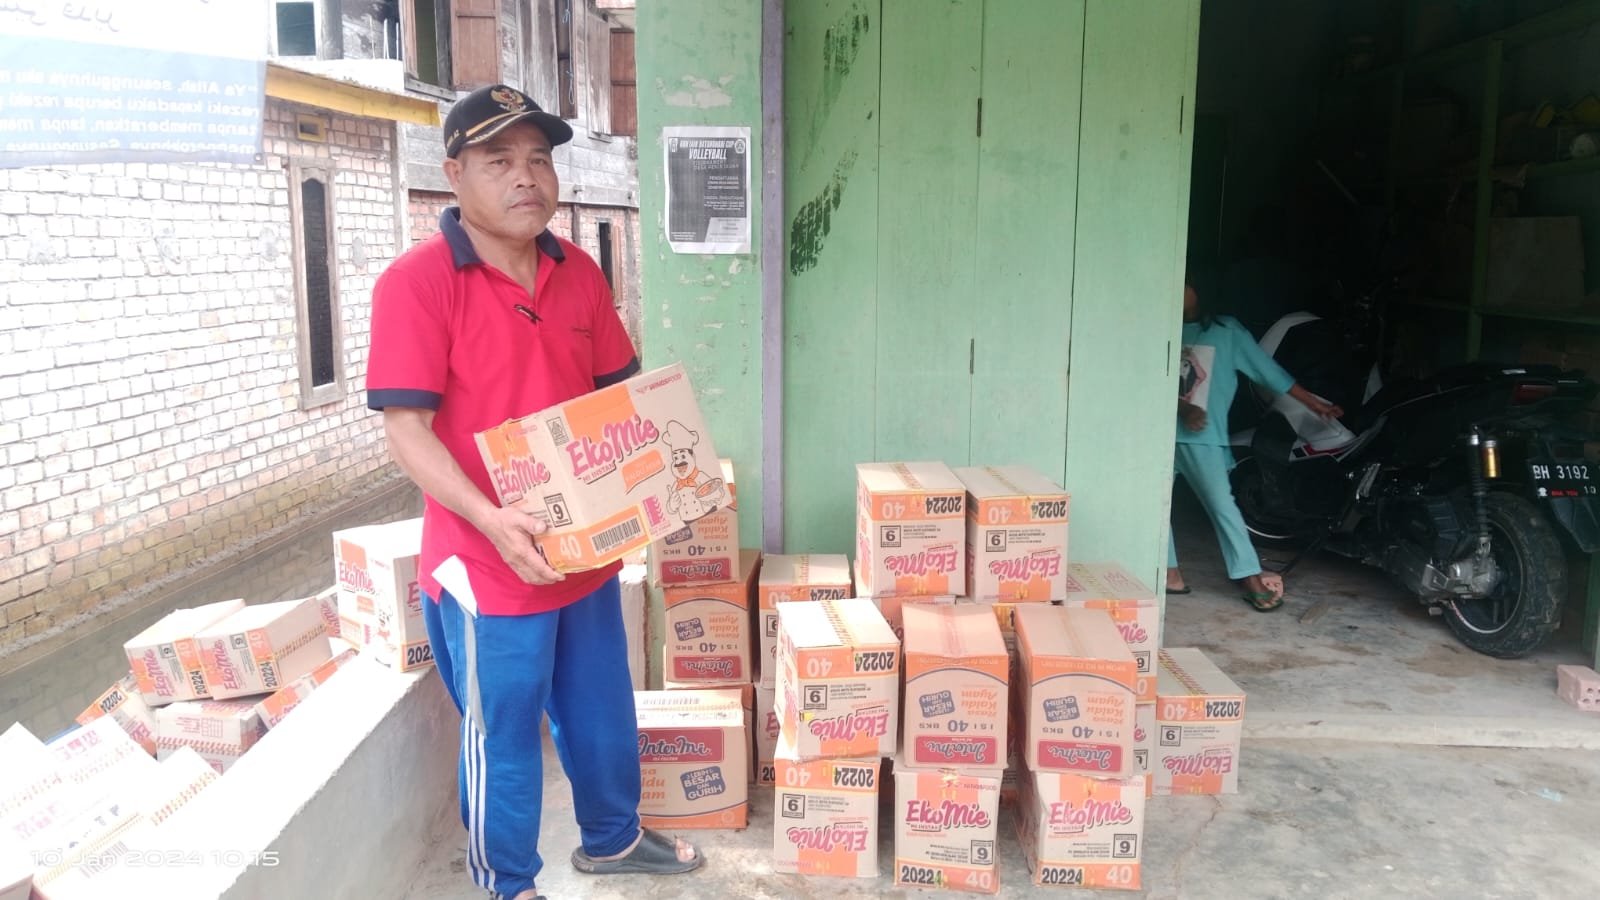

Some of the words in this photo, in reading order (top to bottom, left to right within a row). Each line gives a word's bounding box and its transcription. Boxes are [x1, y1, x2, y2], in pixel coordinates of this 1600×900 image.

[689, 148, 727, 160] VOLLEYBALL
[565, 414, 659, 477] EkoMie
[493, 456, 550, 499] EkoMie
[1532, 465, 1550, 479] BH
[1556, 465, 1589, 479] 3192
[553, 503, 564, 521] 9
[882, 501, 906, 520] 40
[925, 496, 963, 515] 20224
[988, 506, 1012, 524] 40
[559, 535, 581, 560] 40
[688, 545, 706, 556] 40
[669, 562, 722, 579] InterMi
[884, 550, 959, 577] EkoMie
[990, 554, 1062, 582] EkoMie
[339, 561, 374, 592] EkoMie
[699, 642, 717, 653] 40
[681, 661, 733, 677] InterMi
[807, 658, 832, 678] 40
[854, 651, 894, 672] 20224
[810, 690, 821, 704] 9
[1163, 703, 1187, 720] 40
[1206, 700, 1241, 718] 20224
[810, 712, 889, 742] EkoMie
[947, 719, 969, 732] 40
[1072, 725, 1094, 740] 40
[925, 742, 987, 762] InterMi
[1048, 747, 1112, 770] InterMi
[1162, 754, 1232, 776] EkoMie
[684, 773, 720, 788] BESAR
[786, 767, 811, 787] 40
[834, 767, 874, 788] 20224
[688, 785, 722, 800] GURIH
[788, 798, 799, 812] 9
[906, 800, 991, 828] EkoMie
[1048, 798, 1132, 829] EkoMie
[787, 826, 869, 852] EkoMie
[1119, 840, 1131, 854] 9
[977, 847, 988, 860] 9
[902, 865, 942, 886] 20224
[966, 871, 992, 889] 40
[1042, 867, 1083, 885] 20224
[1106, 866, 1133, 883] 40
